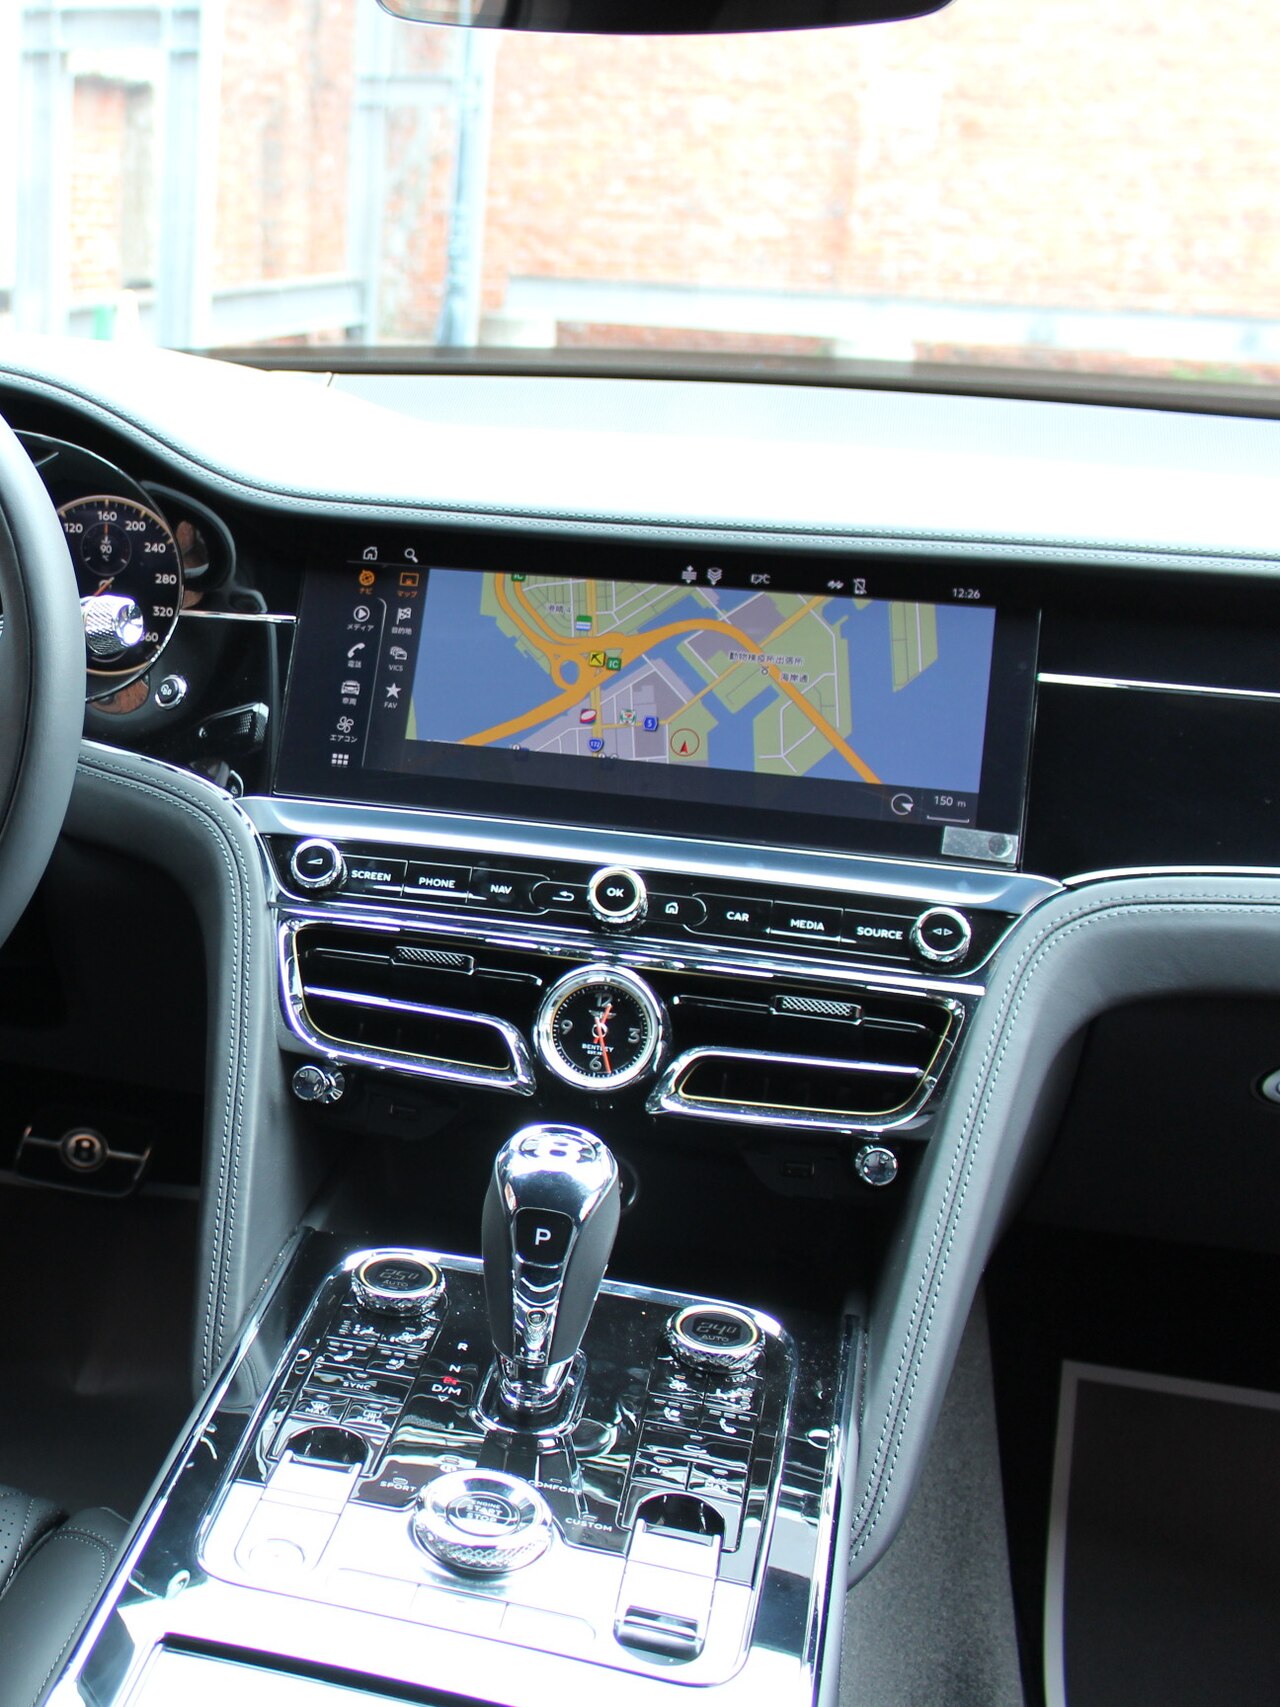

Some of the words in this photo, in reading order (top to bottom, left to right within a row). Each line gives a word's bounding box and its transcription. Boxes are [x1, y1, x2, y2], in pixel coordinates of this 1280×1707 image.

[97, 511, 117, 522] 160
[64, 523, 83, 533] 120
[125, 521, 146, 532] 200
[100, 545, 112, 553] 90
[144, 543, 166, 553] 240
[155, 574, 177, 585] 280
[952, 588, 981, 599] 12:26
[153, 606, 173, 617] 320
[608, 660, 619, 668] IC
[384, 701, 398, 709] FAV
[330, 734, 358, 743] エアコン
[934, 795, 954, 806] 150
[351, 869, 392, 882] SCREEN
[418, 876, 456, 889] PHONE
[490, 884, 513, 895] NAV
[607, 888, 625, 898] OK
[726, 911, 749, 923] CAR
[790, 918, 825, 931] MEDIA
[856, 926, 903, 940] SOURCE
[594, 993, 613, 1008] 12
[561, 1019, 574, 1035] 9
[628, 1027, 641, 1044] 3
[590, 1056, 602, 1070] 6
[534, 1227, 552, 1246] P
[382, 1279, 409, 1287] AUTO
[701, 1334, 730, 1342] AUTO
[457, 1342, 468, 1351] R
[449, 1364, 461, 1373] N
[343, 1381, 371, 1390] SYNC
[431, 1383, 462, 1396] D/M
[380, 1480, 417, 1493] SPORT
[466, 1504, 503, 1516] START
[466, 1513, 497, 1522] STOP
[565, 1517, 613, 1532] CUSTOM
